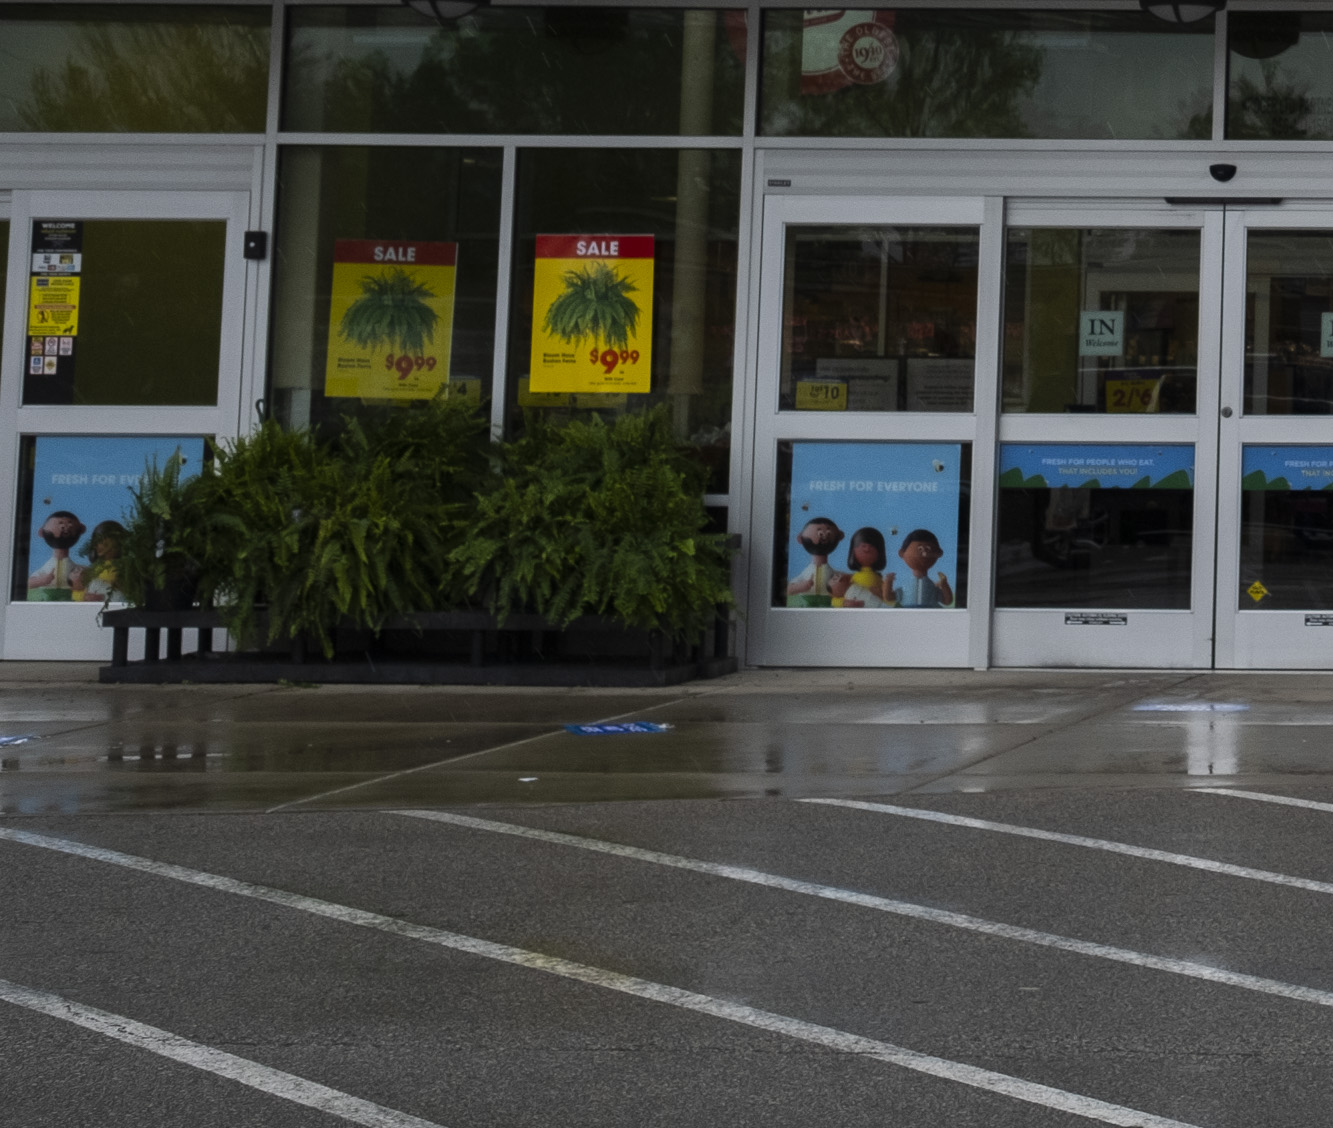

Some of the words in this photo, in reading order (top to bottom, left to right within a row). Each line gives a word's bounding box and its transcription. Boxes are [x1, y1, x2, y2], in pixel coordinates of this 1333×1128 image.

[373, 246, 416, 262] SALE
[576, 240, 619, 256] SALE
[1088, 318, 1116, 335] IN
[1086, 458, 1115, 466] PEOPLE
[1284, 460, 1310, 468] FRESH
[1311, 460, 1328, 468] FOR
[52, 474, 88, 484] FRESH
[92, 474, 116, 485] FOR
[809, 480, 845, 491] FRESH
[849, 480, 873, 491] FOR
[877, 481, 939, 492] EVERYONE
